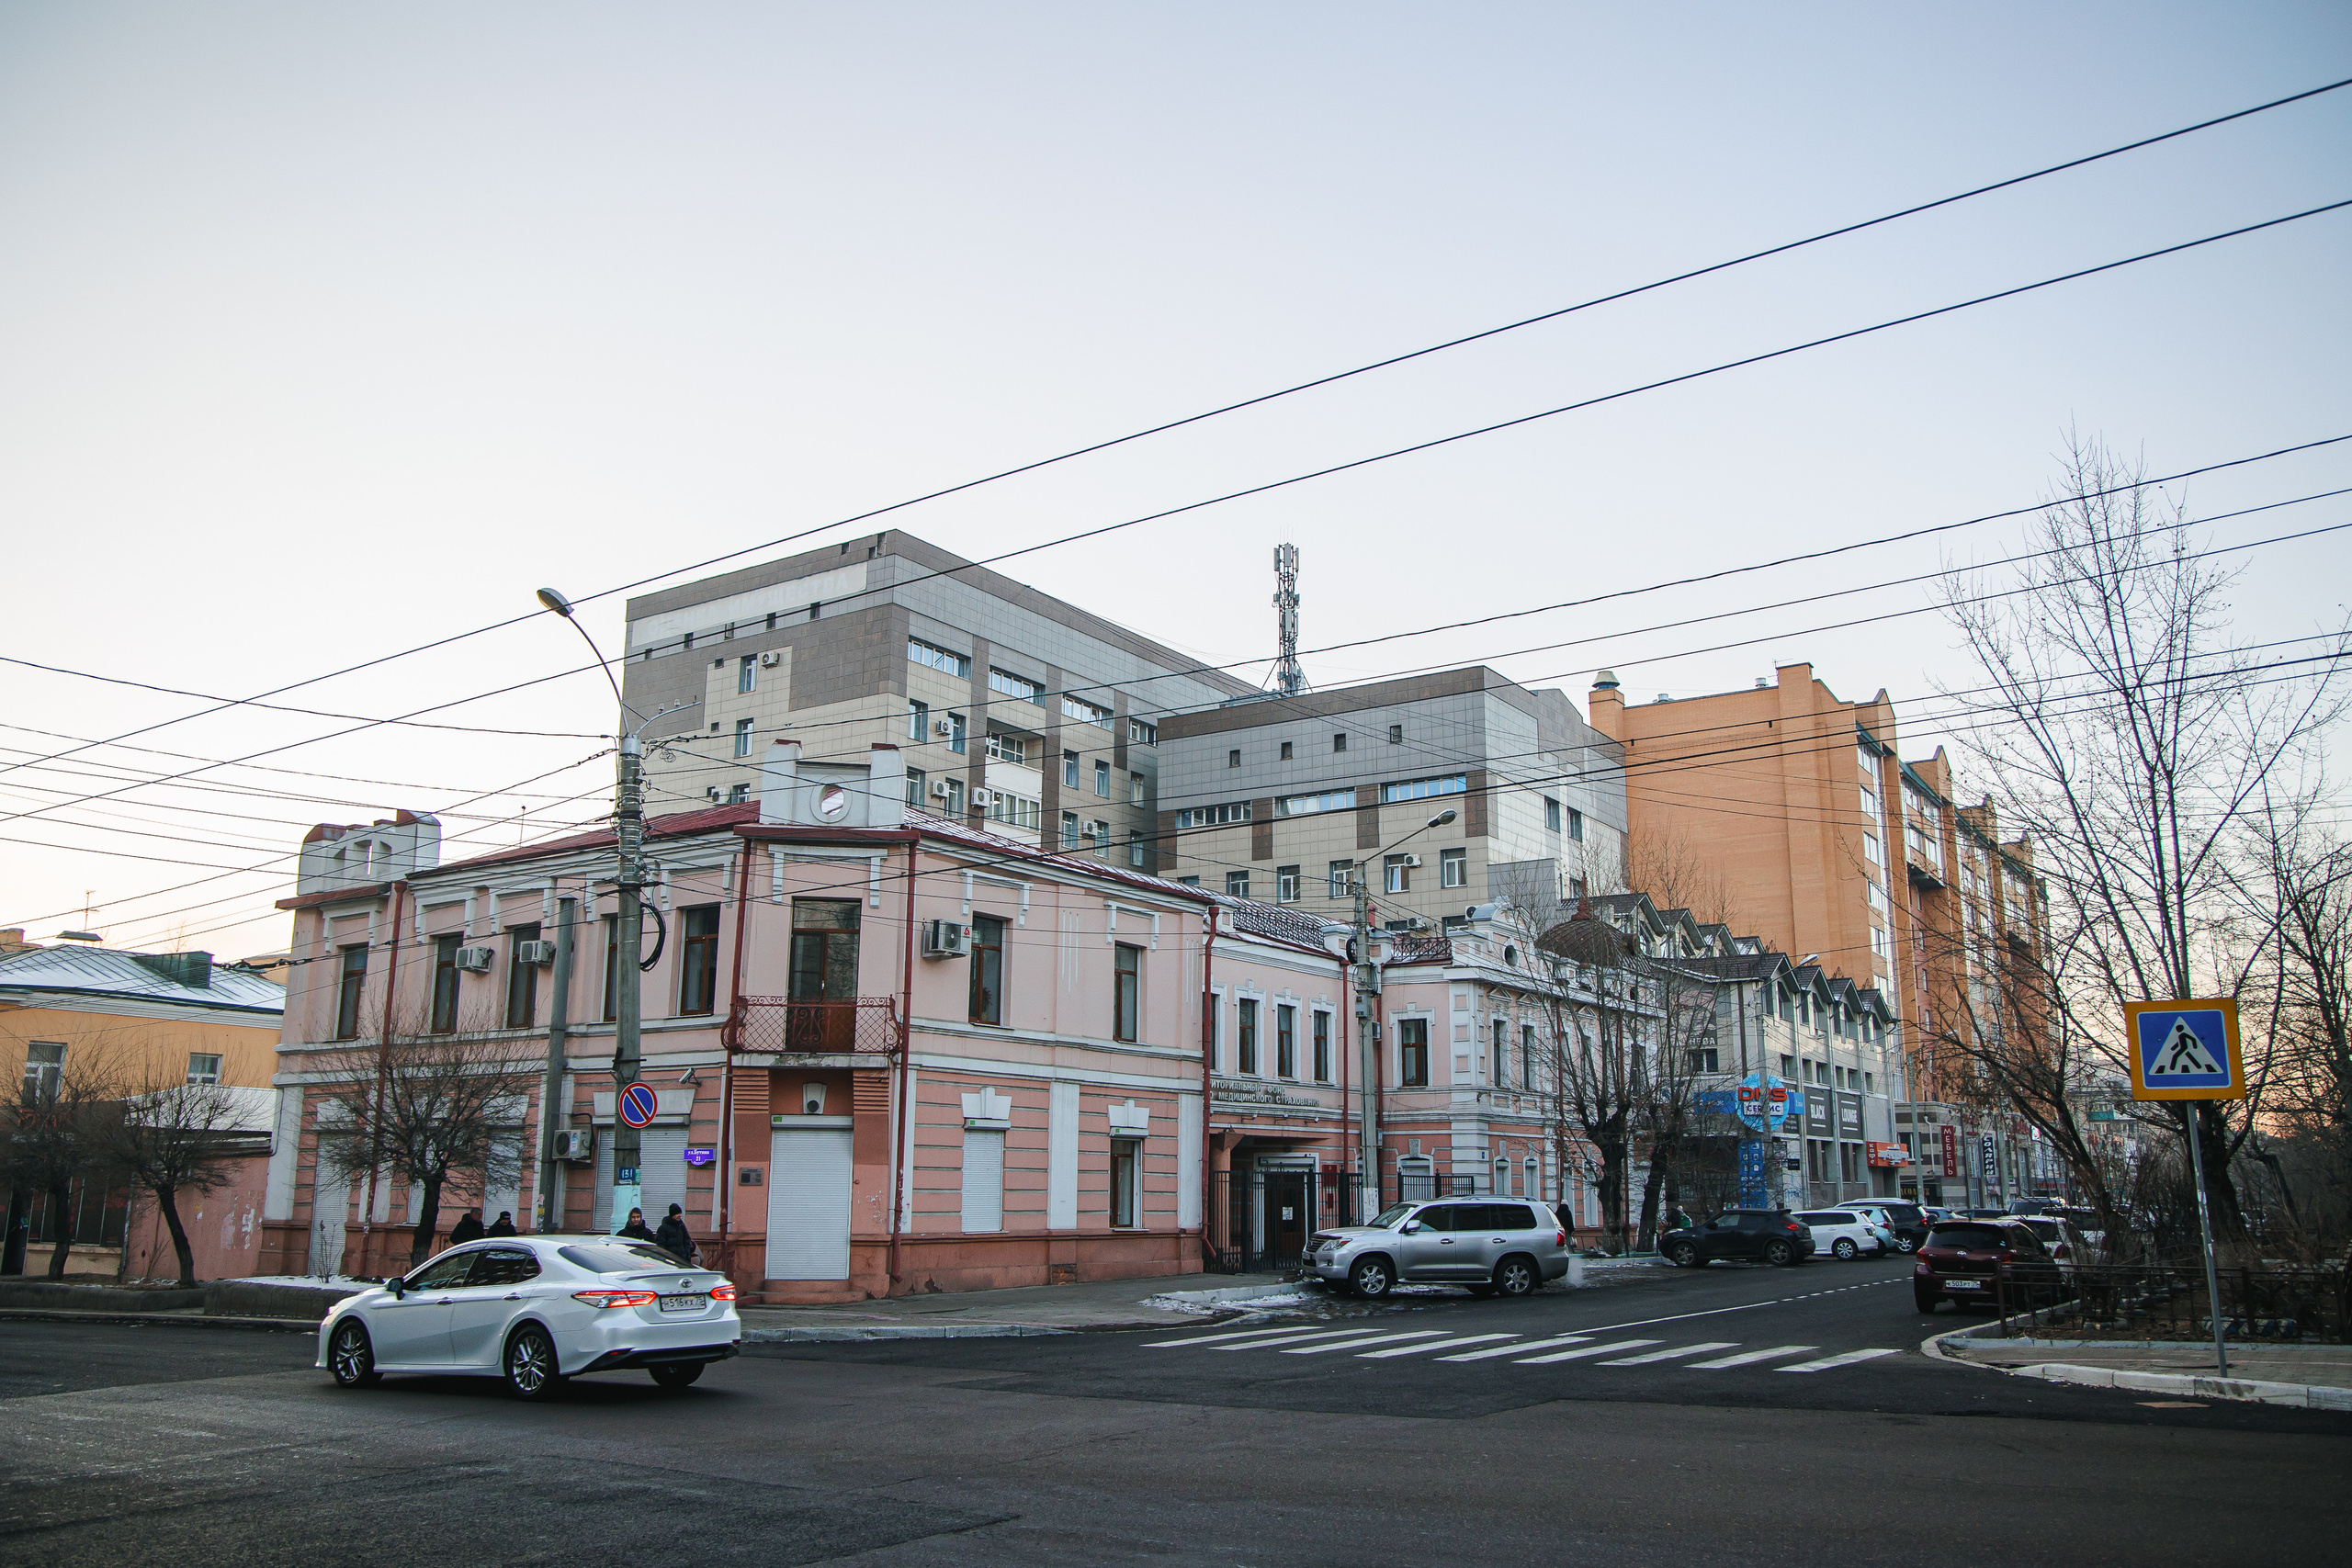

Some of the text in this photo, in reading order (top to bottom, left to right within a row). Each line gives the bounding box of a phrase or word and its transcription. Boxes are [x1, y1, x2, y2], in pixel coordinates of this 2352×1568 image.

[1267, 1085, 1286, 1096] ФОНД
[1218, 1091, 1272, 1103] МЕДИЦИНСКОГО
[1275, 1095, 1320, 1107] СТРАХОВАНИЯ
[1747, 1104, 1781, 1112] СЕРИС
[1943, 1128, 1953, 1175] МЕБЕЛЬ
[621, 1168, 633, 1179] 131
